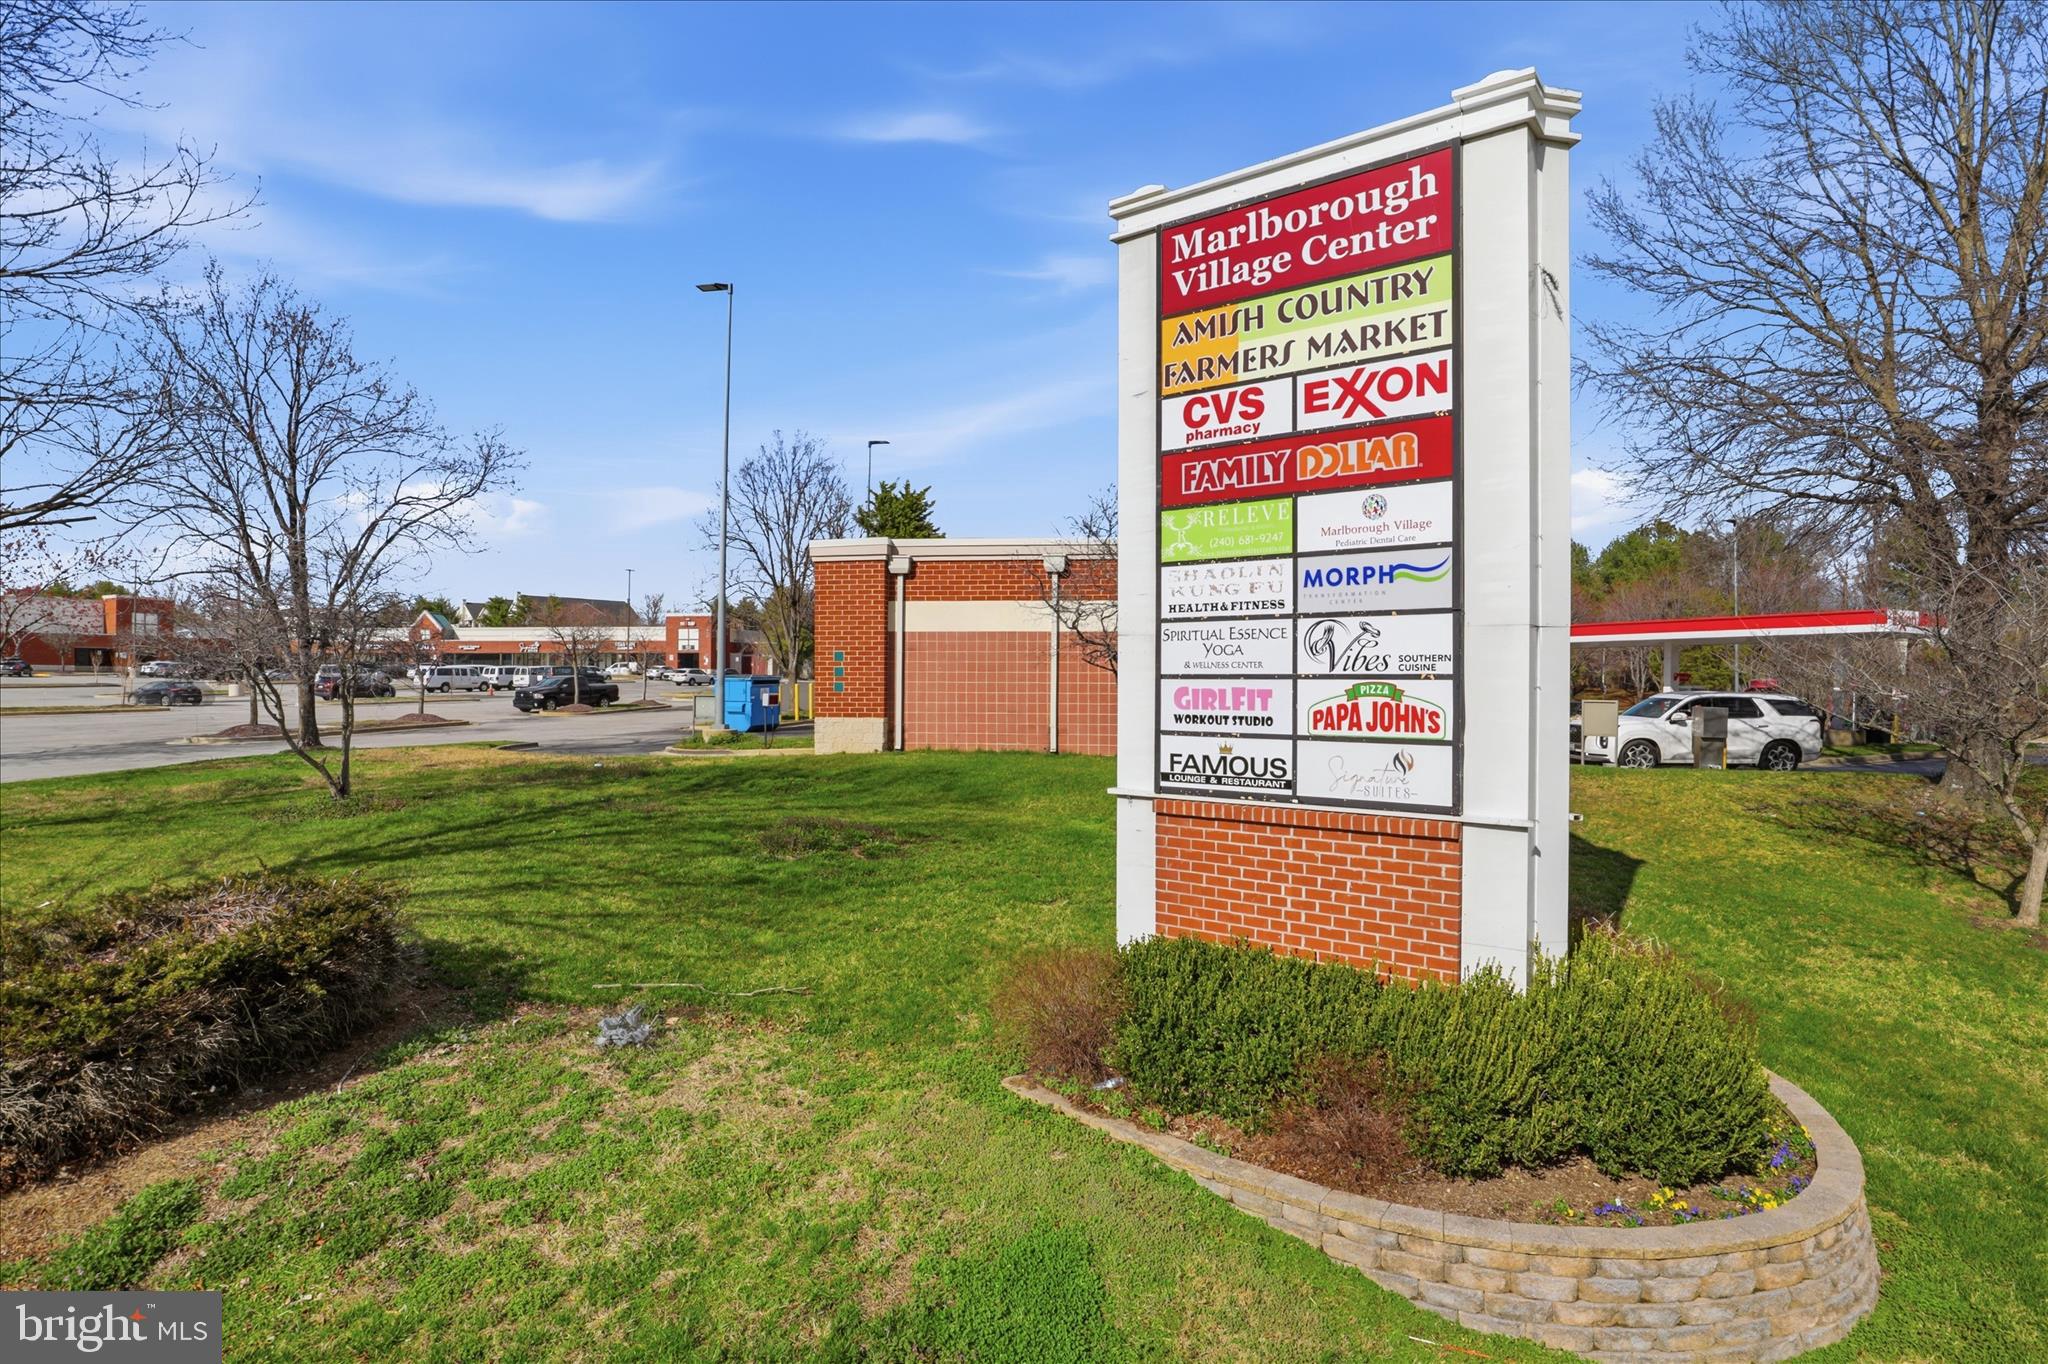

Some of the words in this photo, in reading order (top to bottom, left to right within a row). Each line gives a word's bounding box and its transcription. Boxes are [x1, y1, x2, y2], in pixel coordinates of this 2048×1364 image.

[1171, 165, 1439, 264] Marlborough
[1172, 251, 1292, 297] Village
[1301, 214, 1437, 266] Center
[1172, 304, 1264, 347] AMISH
[1277, 266, 1434, 324] COUNTRY
[1164, 339, 1296, 388] FARMERS
[1307, 309, 1448, 361] MARKET
[1303, 359, 1448, 420] EXXON
[1183, 387, 1265, 430] CVS
[1186, 422, 1260, 444] pharmacy
[1182, 449, 1291, 495] FAMILY
[1297, 432, 1419, 482] DOLLAR
[1203, 502, 1289, 528] RELEVE
[1320, 523, 1390, 538] Marlborough
[1394, 519, 1432, 532] Village
[1335, 538, 1367, 547] Pediatric
[1370, 535, 1396, 545] Dental
[1397, 534, 1416, 543] Care
[1209, 536, 1234, 549] (240)
[1248, 580, 1283, 594] FU
[1303, 564, 1395, 588] MORPH
[1163, 628, 1226, 642] SPIRITUAL
[1229, 626, 1288, 640] ESSENCE
[1202, 642, 1244, 658] YOGA
[1325, 631, 1391, 673] Vibes
[1398, 654, 1452, 663] SOUTHERN
[1184, 661, 1191, 669] &
[1192, 661, 1229, 669] WELLNESS
[1231, 661, 1264, 669] CENTER
[1398, 663, 1437, 672] CUISINE
[1173, 686, 1273, 711] GIRLFIT
[1360, 684, 1389, 695] PIZZA
[1173, 714, 1229, 725] WORKOUT
[1232, 715, 1274, 727] STUDIO
[1313, 702, 1363, 731] PAPA
[1366, 701, 1441, 734] JOHN'S
[1169, 753, 1288, 779] FAMOUS
[1328, 755, 1410, 795] Signature
[1169, 774, 1206, 784] LOUNGE
[1221, 778, 1286, 789] RESTAURANT
